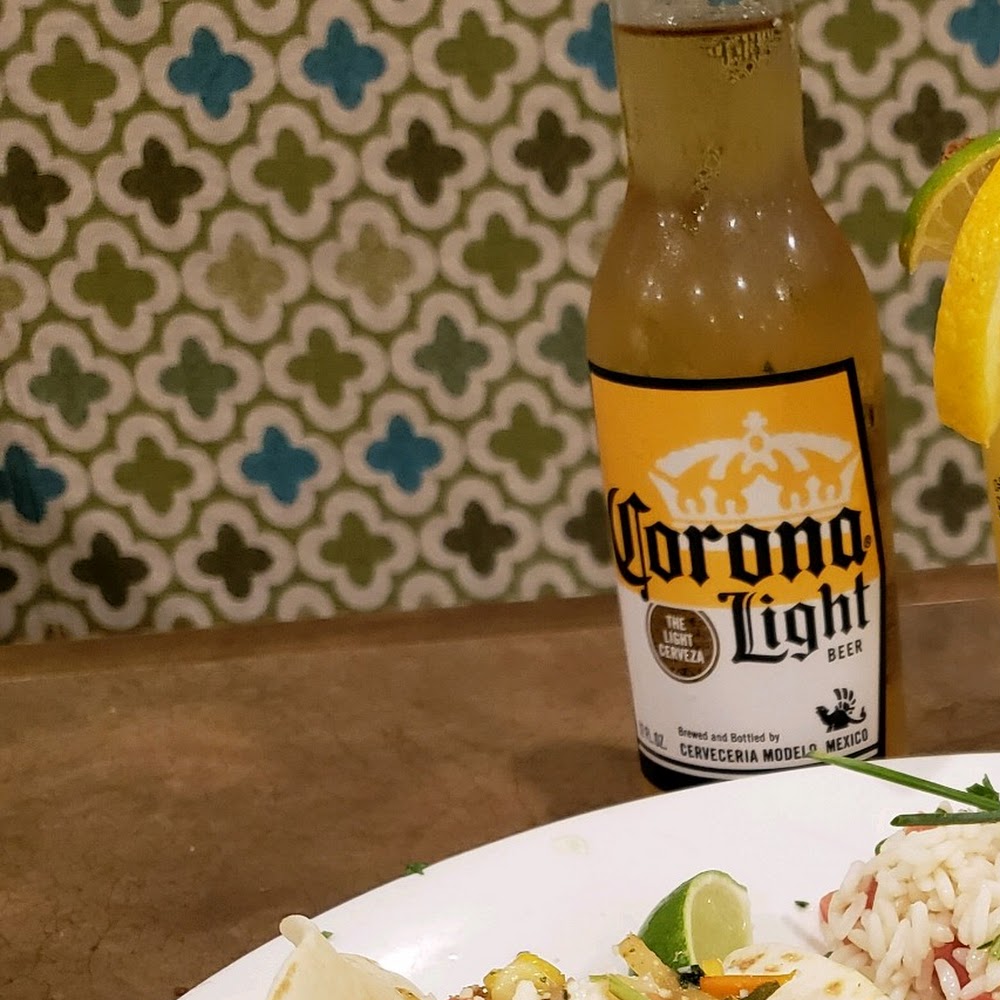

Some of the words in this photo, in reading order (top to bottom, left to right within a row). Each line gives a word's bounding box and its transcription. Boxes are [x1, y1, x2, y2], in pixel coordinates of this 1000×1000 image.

[608, 487, 867, 602] Corona
[665, 614, 688, 631] THE
[717, 571, 871, 664] Light
[662, 629, 694, 648] LIGHT
[658, 643, 705, 664] CERVEZA
[826, 638, 864, 663] BEER
[678, 726, 709, 741] Brewed
[711, 732, 728, 743] and
[730, 732, 766, 744] Bottled
[768, 731, 781, 744] by
[680, 742, 759, 763] CERVECERIA
[826, 727, 869, 754] MEXICO
